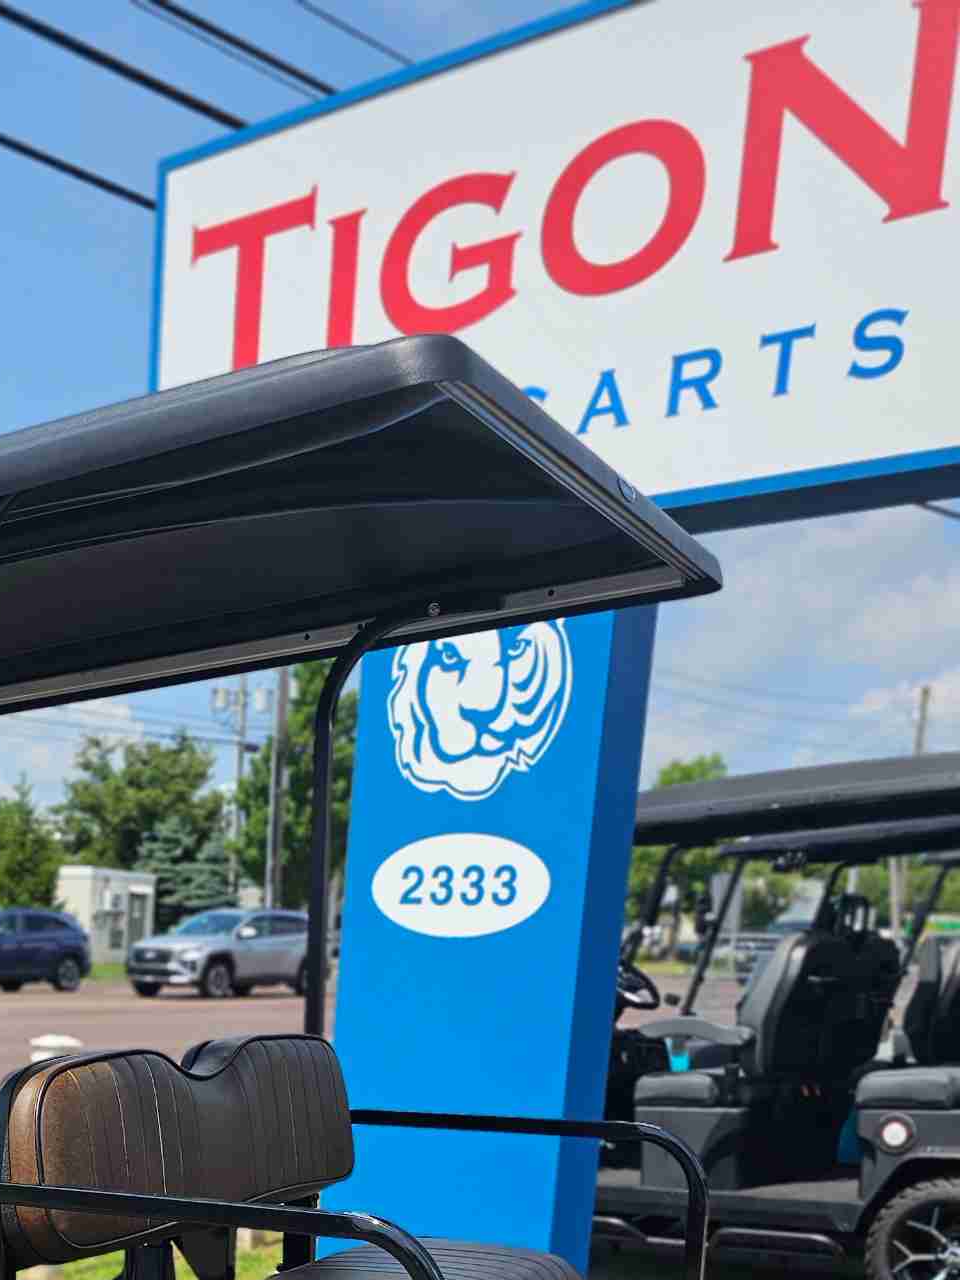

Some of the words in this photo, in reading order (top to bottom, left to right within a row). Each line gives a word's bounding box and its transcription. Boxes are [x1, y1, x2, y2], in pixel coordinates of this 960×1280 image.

[191, 0, 960, 370] TIGON
[520, 308, 908, 435] ARTS
[399, 864, 517, 906] 2333
